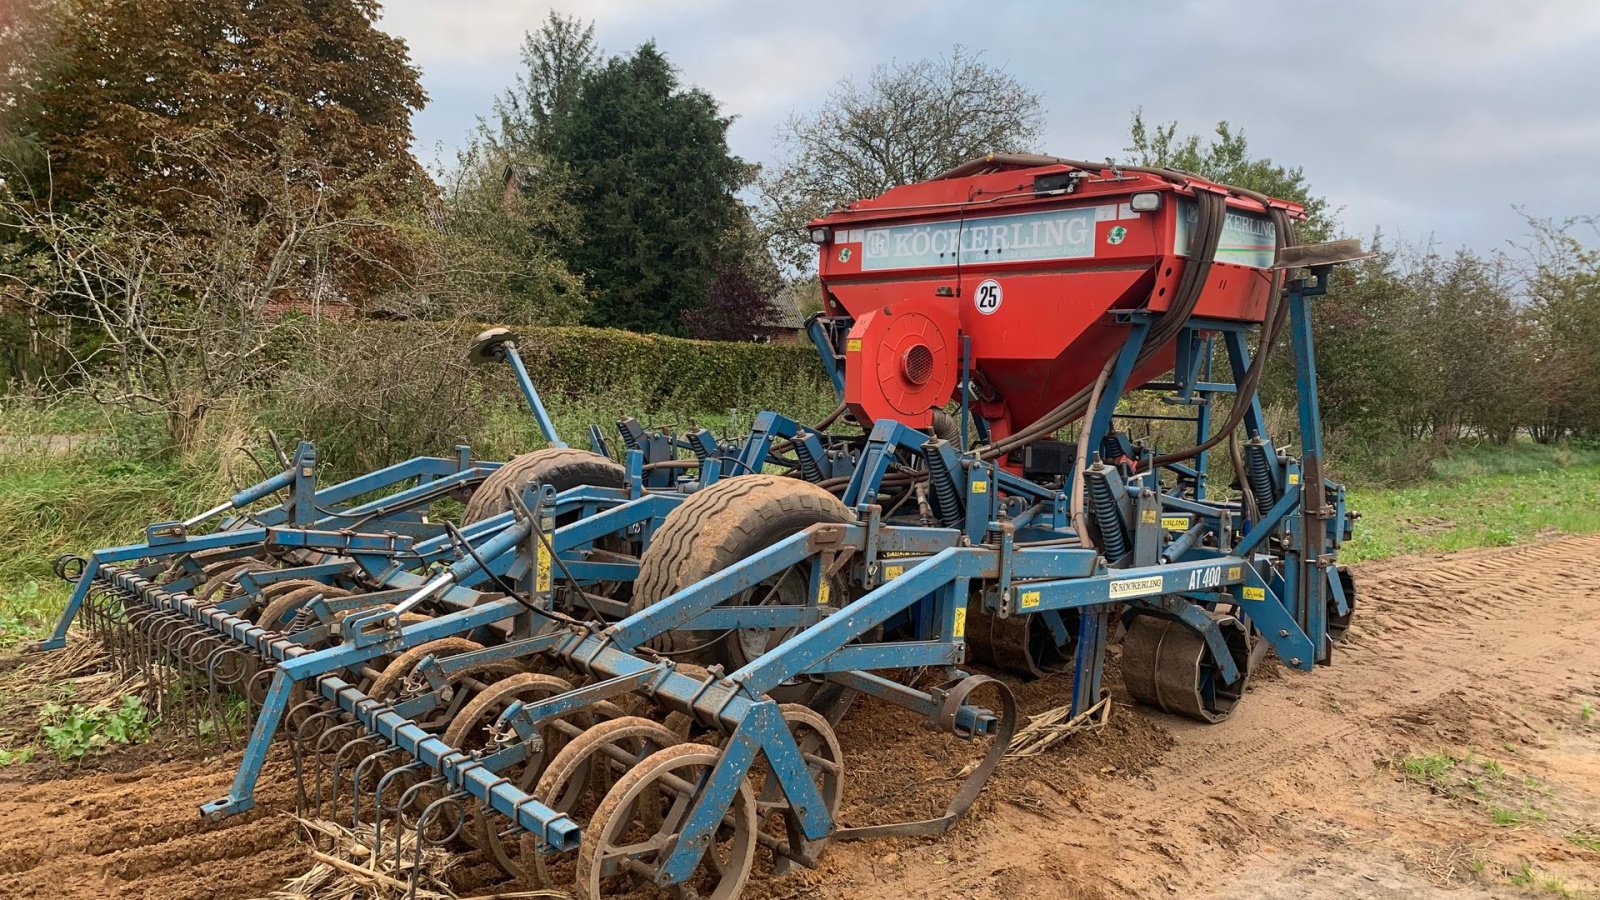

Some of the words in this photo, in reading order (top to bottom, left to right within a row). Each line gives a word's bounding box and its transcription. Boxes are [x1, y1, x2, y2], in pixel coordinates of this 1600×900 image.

[894, 217, 1090, 257] KÖCKERLING
[1225, 213, 1276, 238] KERLING
[980, 286, 997, 307] 25
[1189, 569, 1203, 590] AT
[1203, 567, 1221, 588] 400
